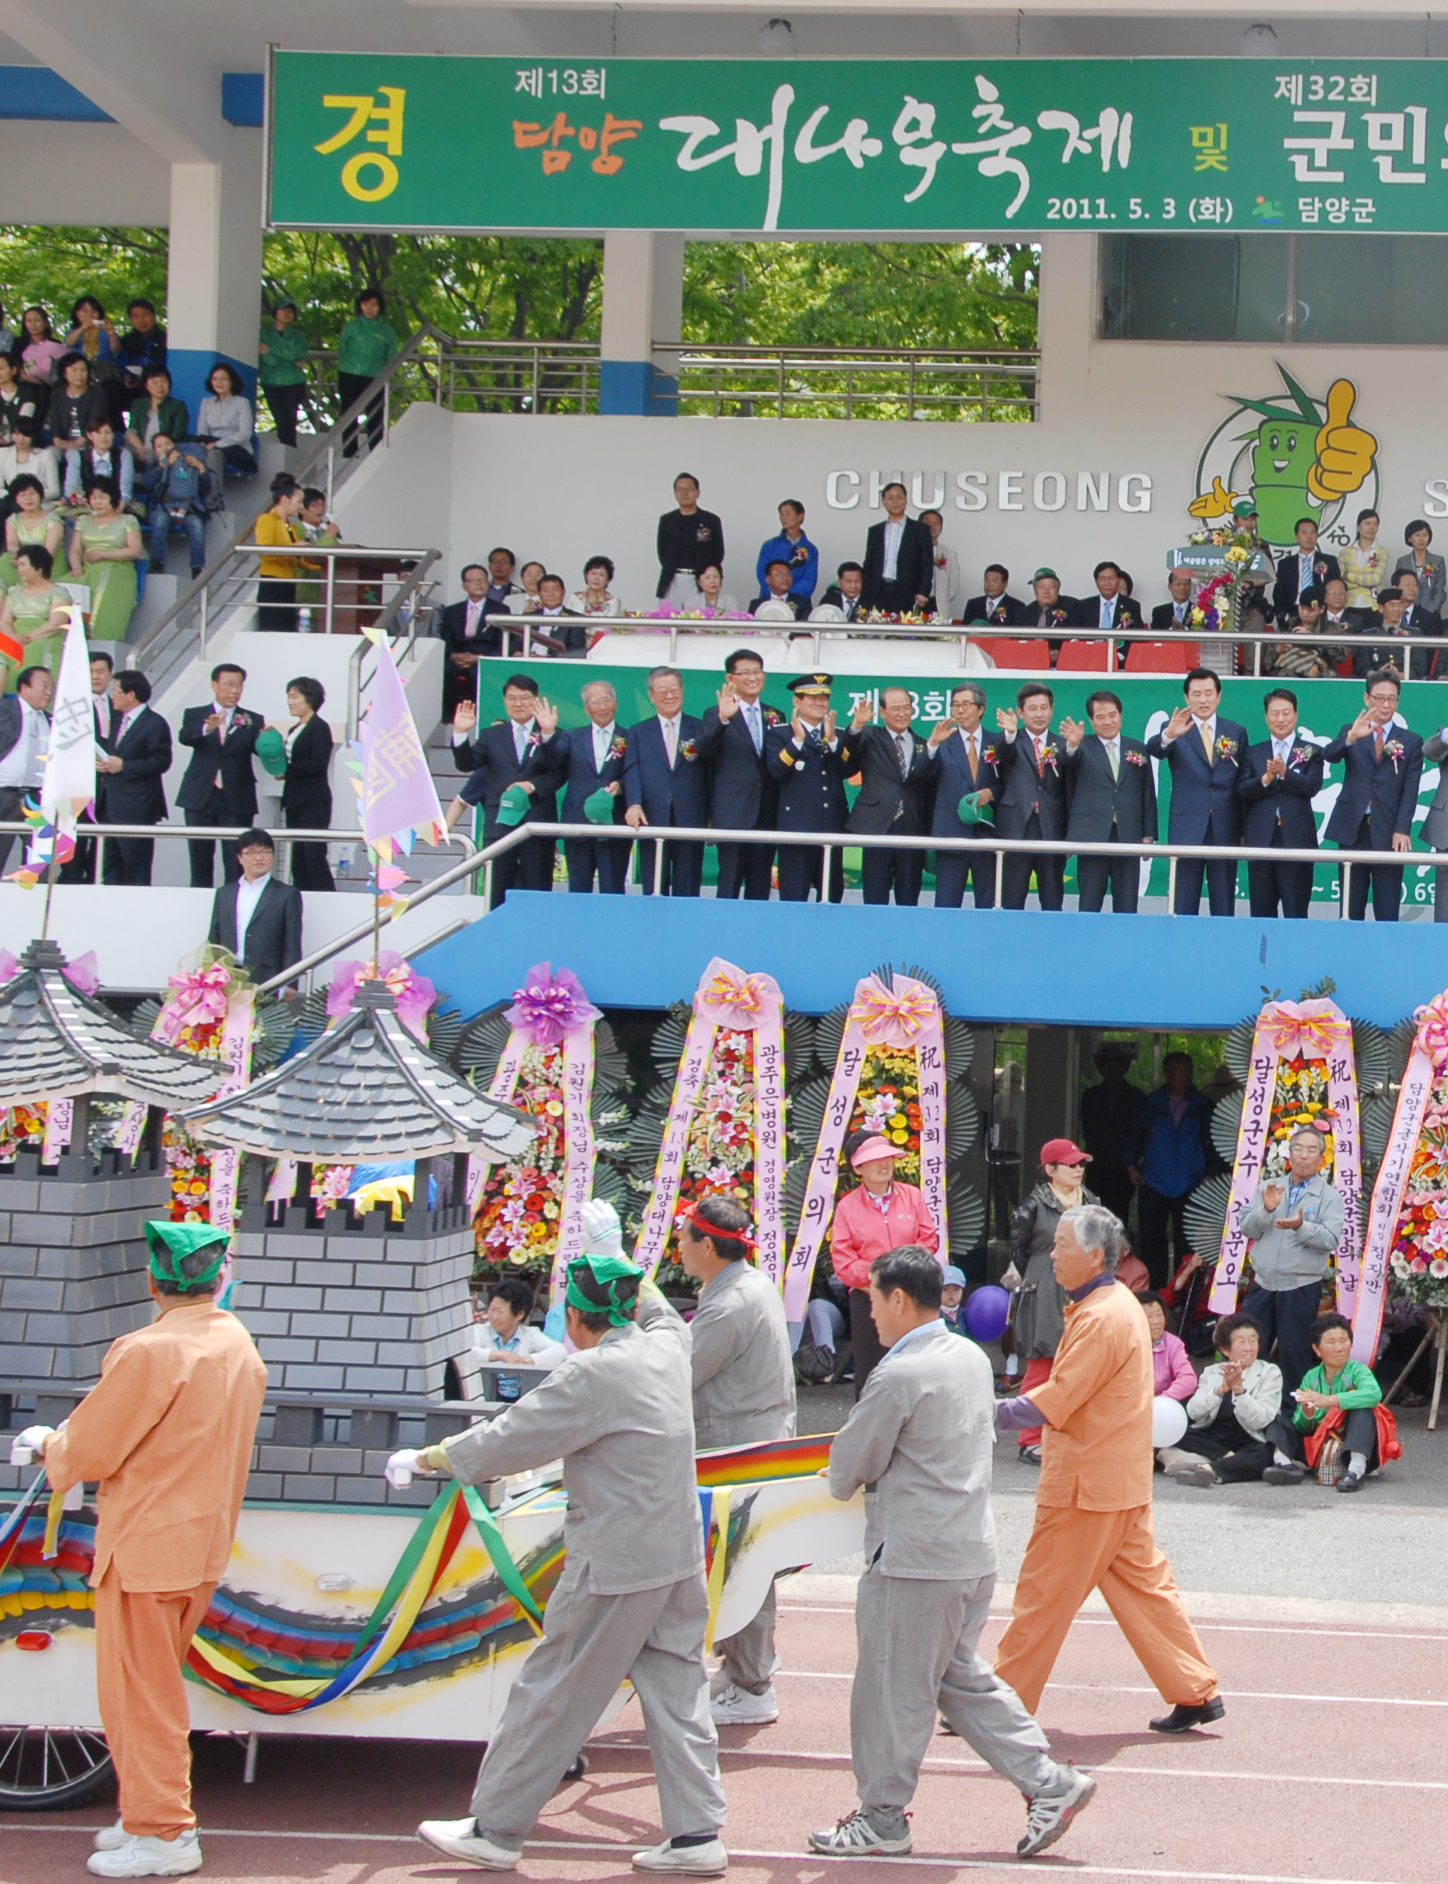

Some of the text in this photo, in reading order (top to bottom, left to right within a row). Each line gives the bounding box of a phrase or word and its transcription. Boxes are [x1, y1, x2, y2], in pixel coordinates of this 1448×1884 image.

[514, 67, 606, 99] 제13회
[1274, 74, 1378, 106] 제32회
[318, 85, 405, 202] 경
[512, 82, 1133, 231] 담양 대나무축제
[1189, 122, 1229, 172] 및
[1046, 197, 1234, 224] 2011. 5. 3 (화)
[1298, 196, 1376, 224] 담양군
[826, 469, 1153, 513] CHUSEONG
[920, 1044, 942, 1070] 祝
[1330, 1058, 1353, 1084] 祝
[569, 1062, 585, 1104] 김원기
[758, 1044, 780, 1150] 광주은병원
[570, 1112, 588, 1153] 회장님
[1238, 1055, 1274, 1179] 달성군수
[791, 1047, 862, 1272] 달성군의회
[570, 1160, 588, 1202] 수상을
[762, 1160, 776, 1222] 경영원장
[637, 1175, 676, 1272] 담양대나무축
[1339, 1273, 1359, 1293] 날
